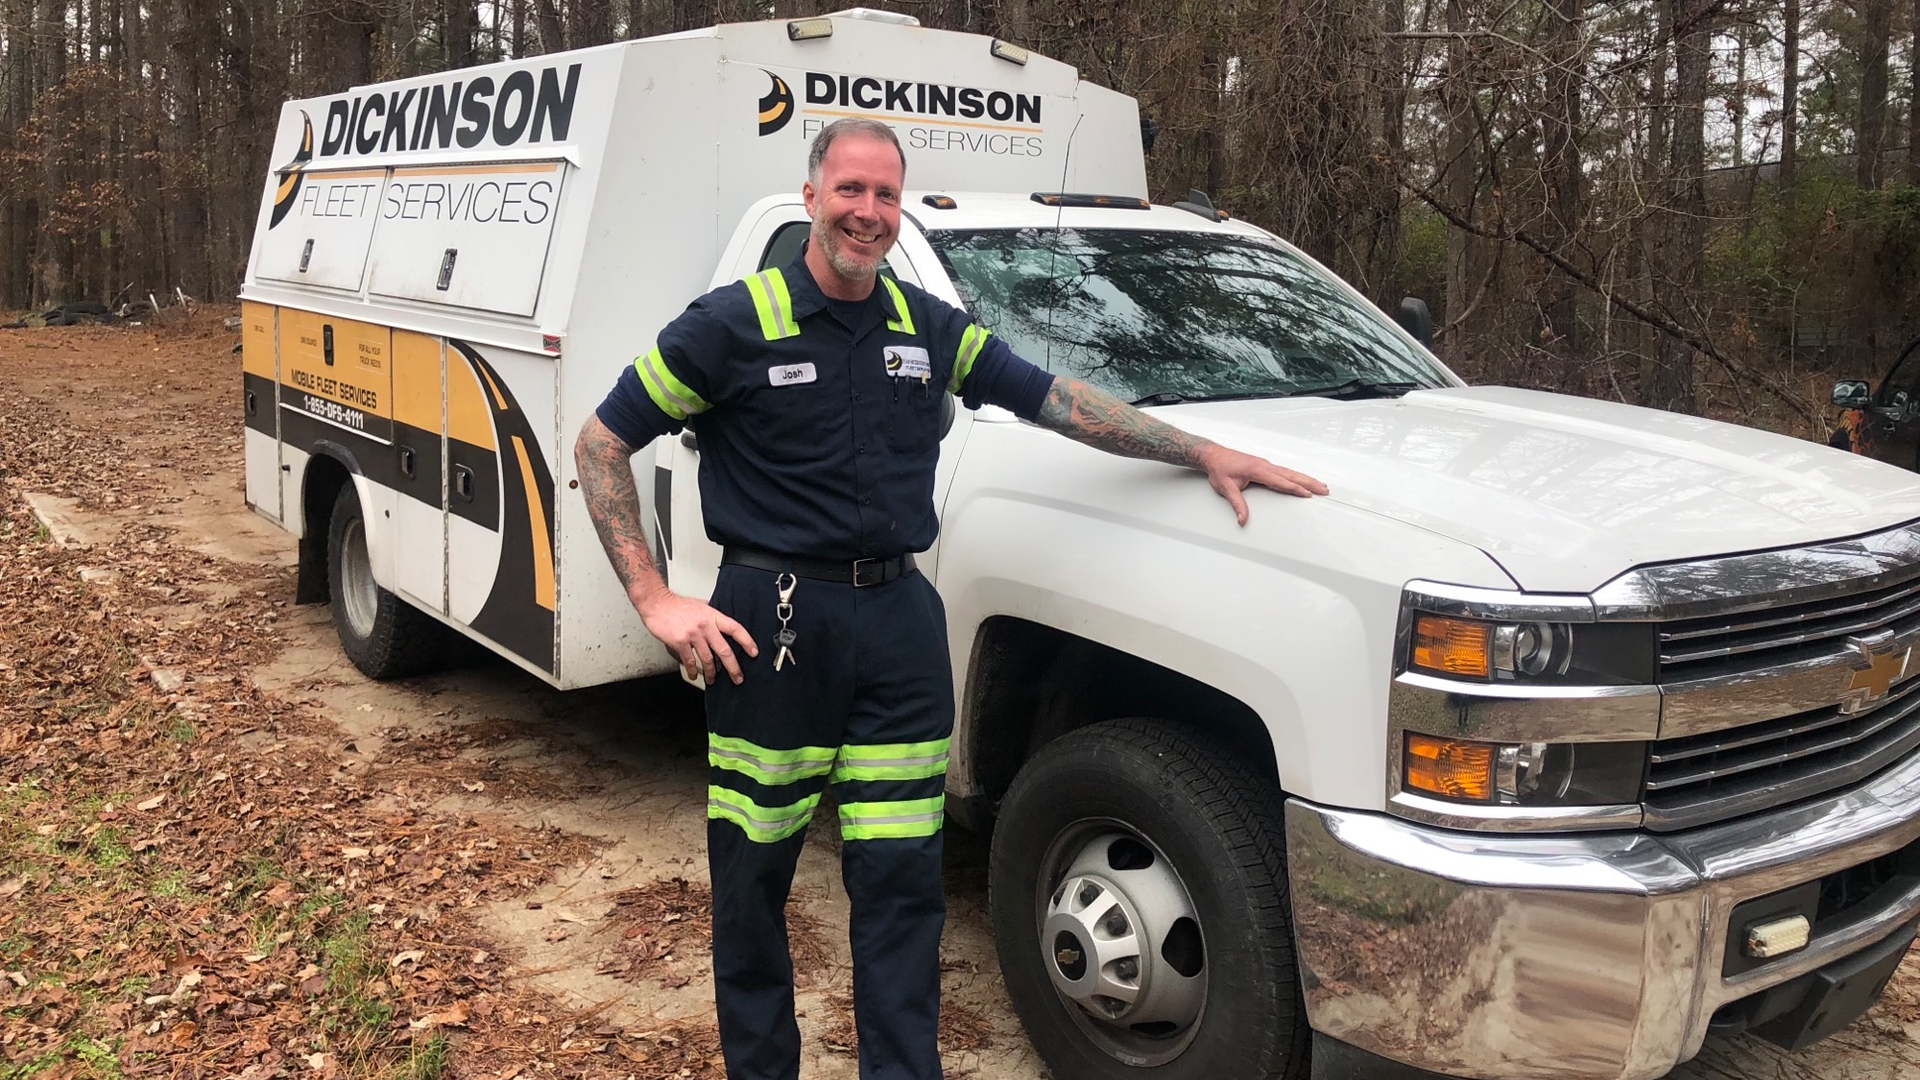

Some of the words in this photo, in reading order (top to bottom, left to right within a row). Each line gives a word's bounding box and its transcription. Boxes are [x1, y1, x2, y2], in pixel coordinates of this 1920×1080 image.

[320, 63, 582, 156] DICKINSON
[805, 72, 1041, 123] DICKINSON
[909, 127, 1043, 157] SERVICES
[299, 184, 376, 218] FLEET
[384, 180, 553, 224] SERVICES
[359, 355, 370, 365] TRUCK
[370, 358, 382, 368] NEEDS
[372, 347, 381, 355] YOUR
[291, 369, 315, 390] MOBILE
[316, 376, 338, 397] FLEET
[340, 382, 377, 409] SERVICES
[782, 368, 804, 380] Josh
[303, 395, 364, 429] 1-855-DFS-4111
